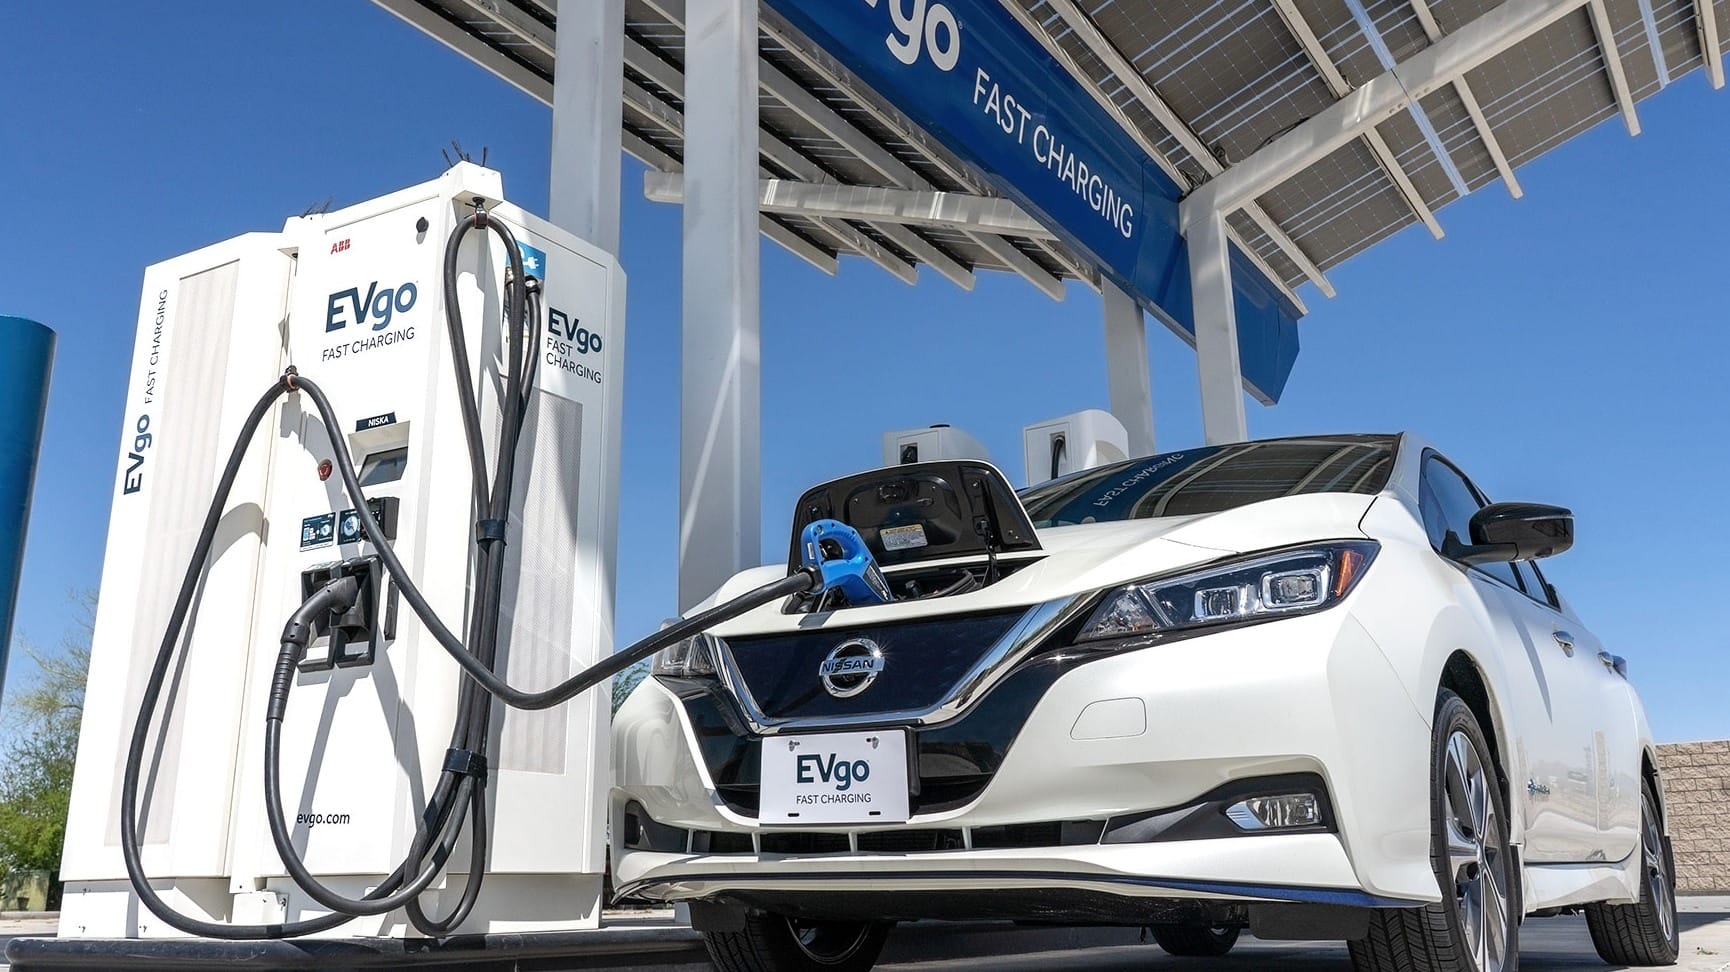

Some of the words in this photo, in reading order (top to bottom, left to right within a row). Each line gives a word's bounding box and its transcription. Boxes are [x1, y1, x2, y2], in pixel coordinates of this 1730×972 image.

[865, 0, 960, 71] go
[973, 67, 1032, 144] FAST
[1033, 125, 1133, 238] CHARGING
[330, 238, 351, 255] ABB
[325, 280, 418, 332] EVgo
[150, 289, 168, 366] CHARGING
[321, 343, 351, 362] FAST
[351, 326, 415, 354] CHARGING
[548, 306, 603, 355] EVgo
[546, 337, 573, 357] FAST
[546, 352, 602, 384] CHARGING
[144, 370, 157, 404] FAST
[367, 415, 390, 427] NISKA
[123, 414, 153, 495] EVgo
[822, 659, 874, 673] NISSAN
[796, 753, 870, 791] EVgo
[796, 795, 819, 805] FAST
[820, 792, 872, 805] CHARGING
[296, 813, 351, 829] evgo.com
